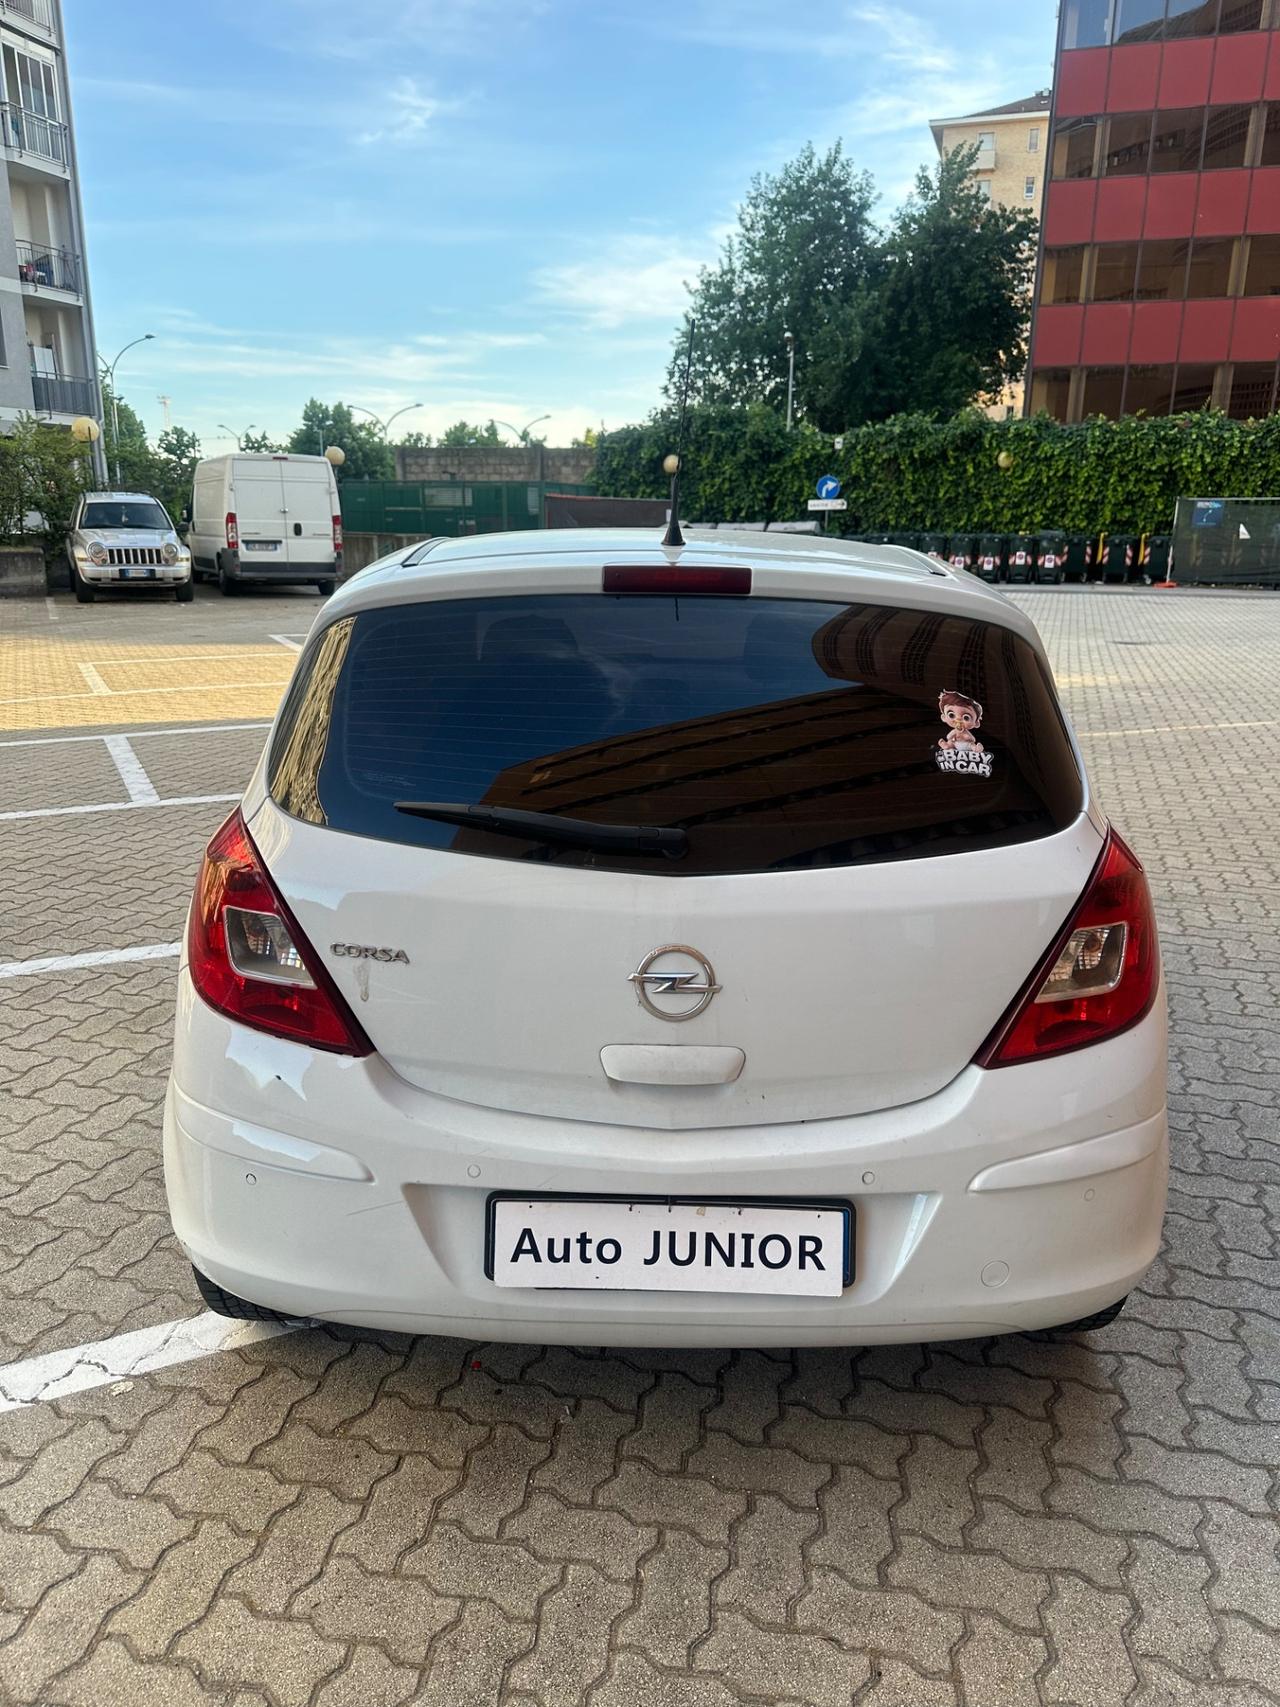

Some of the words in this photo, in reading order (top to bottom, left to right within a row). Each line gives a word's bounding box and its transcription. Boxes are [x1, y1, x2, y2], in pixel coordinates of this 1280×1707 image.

[943, 749, 992, 764] BABY
[940, 761, 955, 770] IN
[955, 760, 991, 778] CAR
[330, 942, 410, 965] CORSA
[510, 1227, 623, 1265] Auto
[643, 1230, 827, 1272] JUNIOR
